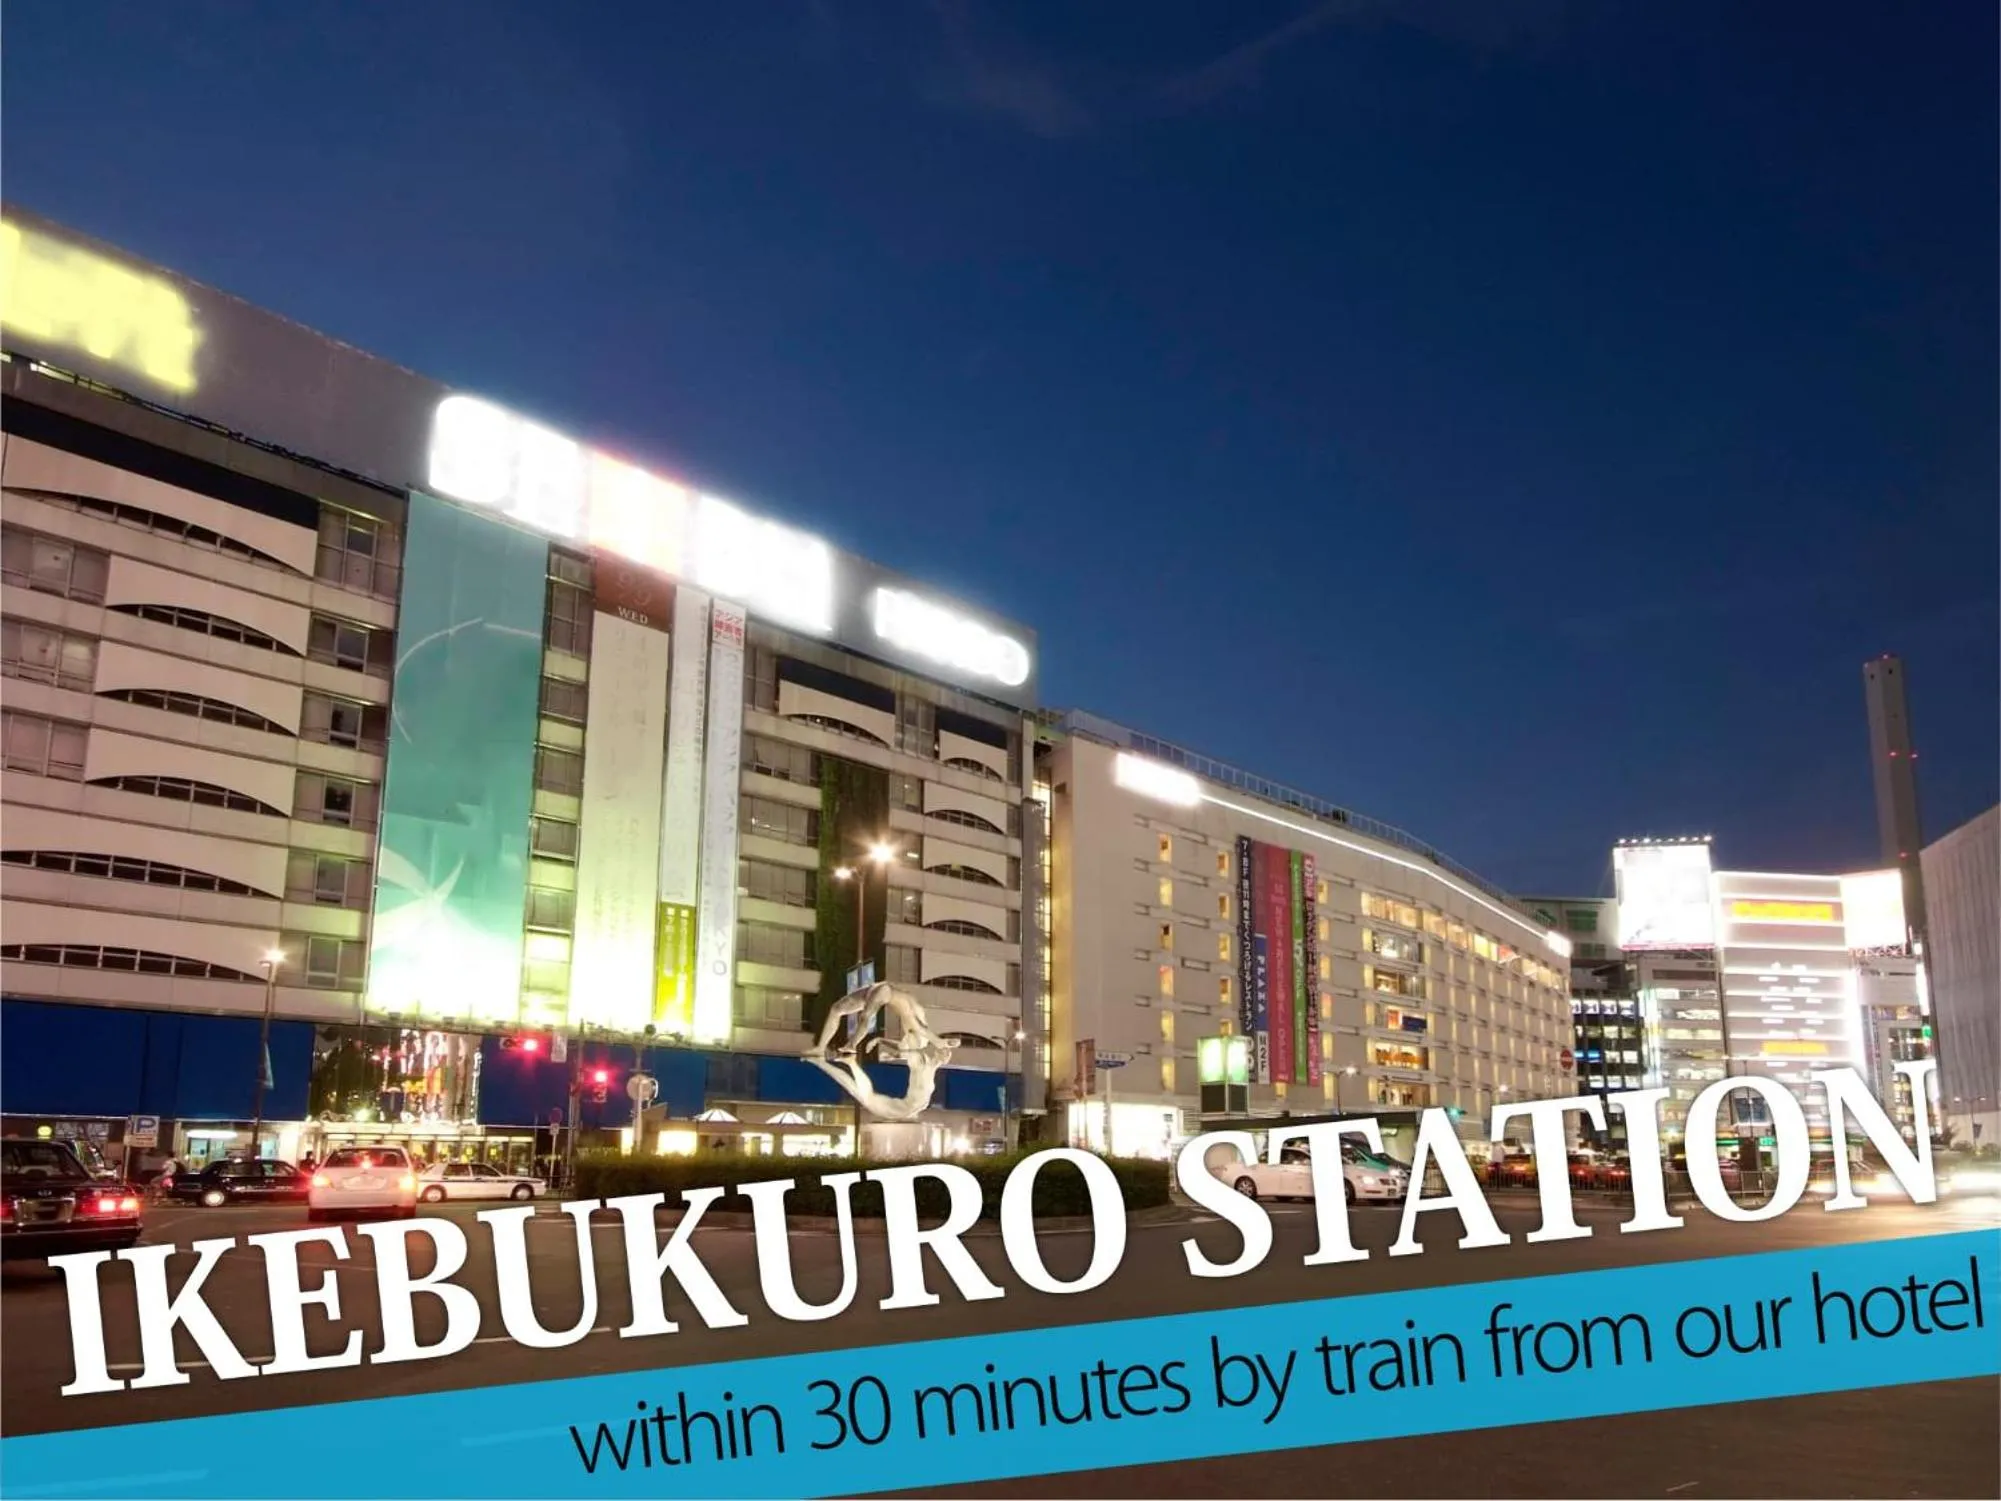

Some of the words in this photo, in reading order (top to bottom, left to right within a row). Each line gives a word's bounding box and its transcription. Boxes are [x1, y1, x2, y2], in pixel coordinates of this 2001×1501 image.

[617, 606, 649, 625] WED
[1257, 954, 1267, 1014] PLAZA
[137, 1117, 156, 1133] P
